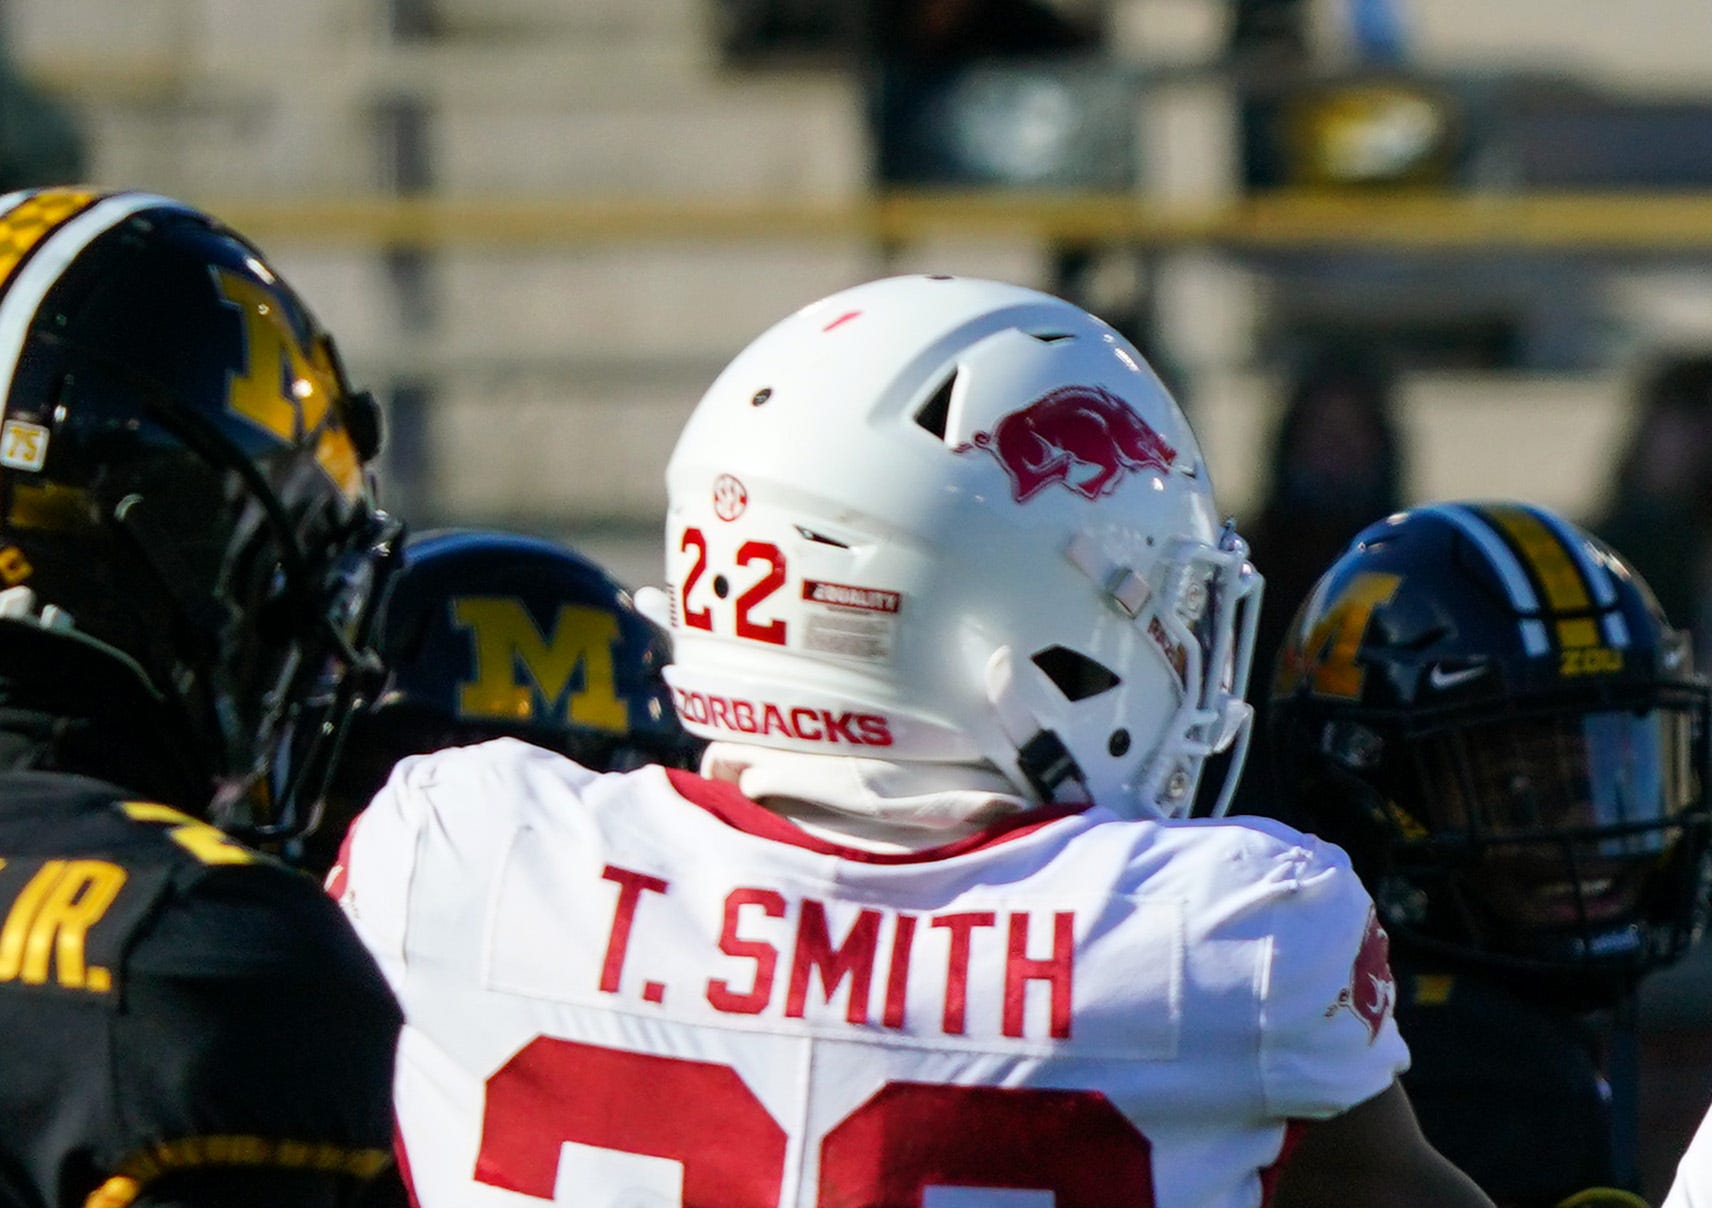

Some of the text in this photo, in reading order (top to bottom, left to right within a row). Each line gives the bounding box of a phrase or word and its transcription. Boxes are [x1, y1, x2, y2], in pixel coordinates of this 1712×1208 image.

[7, 426, 42, 462] 75
[681, 527, 786, 646] 22
[452, 597, 630, 735] M
[598, 865, 1076, 1040] T. SMITH
